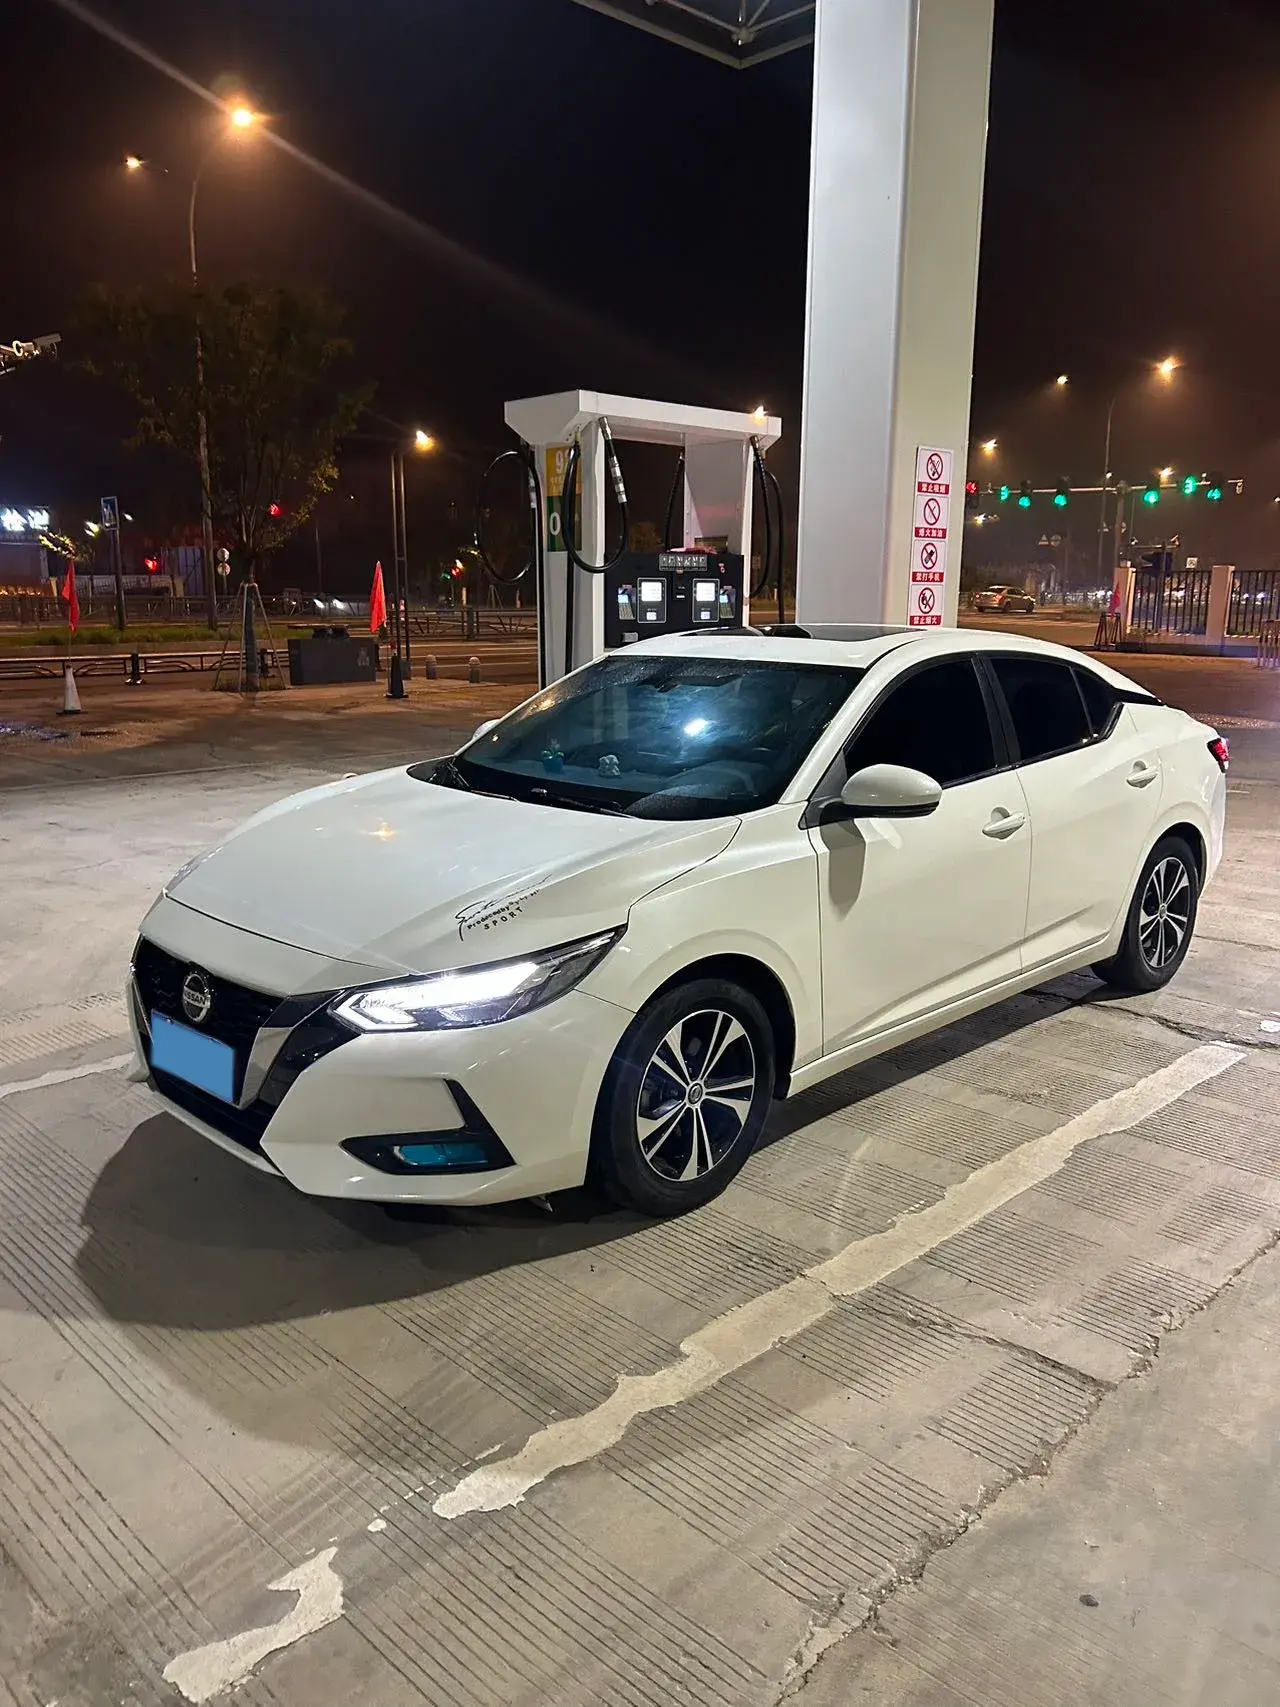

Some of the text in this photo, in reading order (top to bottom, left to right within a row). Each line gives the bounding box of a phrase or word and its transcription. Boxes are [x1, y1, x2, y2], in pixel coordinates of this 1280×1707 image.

[921, 483, 946, 494] 禁止吸烟
[484, 907, 523, 930] SPORT
[184, 989, 208, 1007] NISSAN
